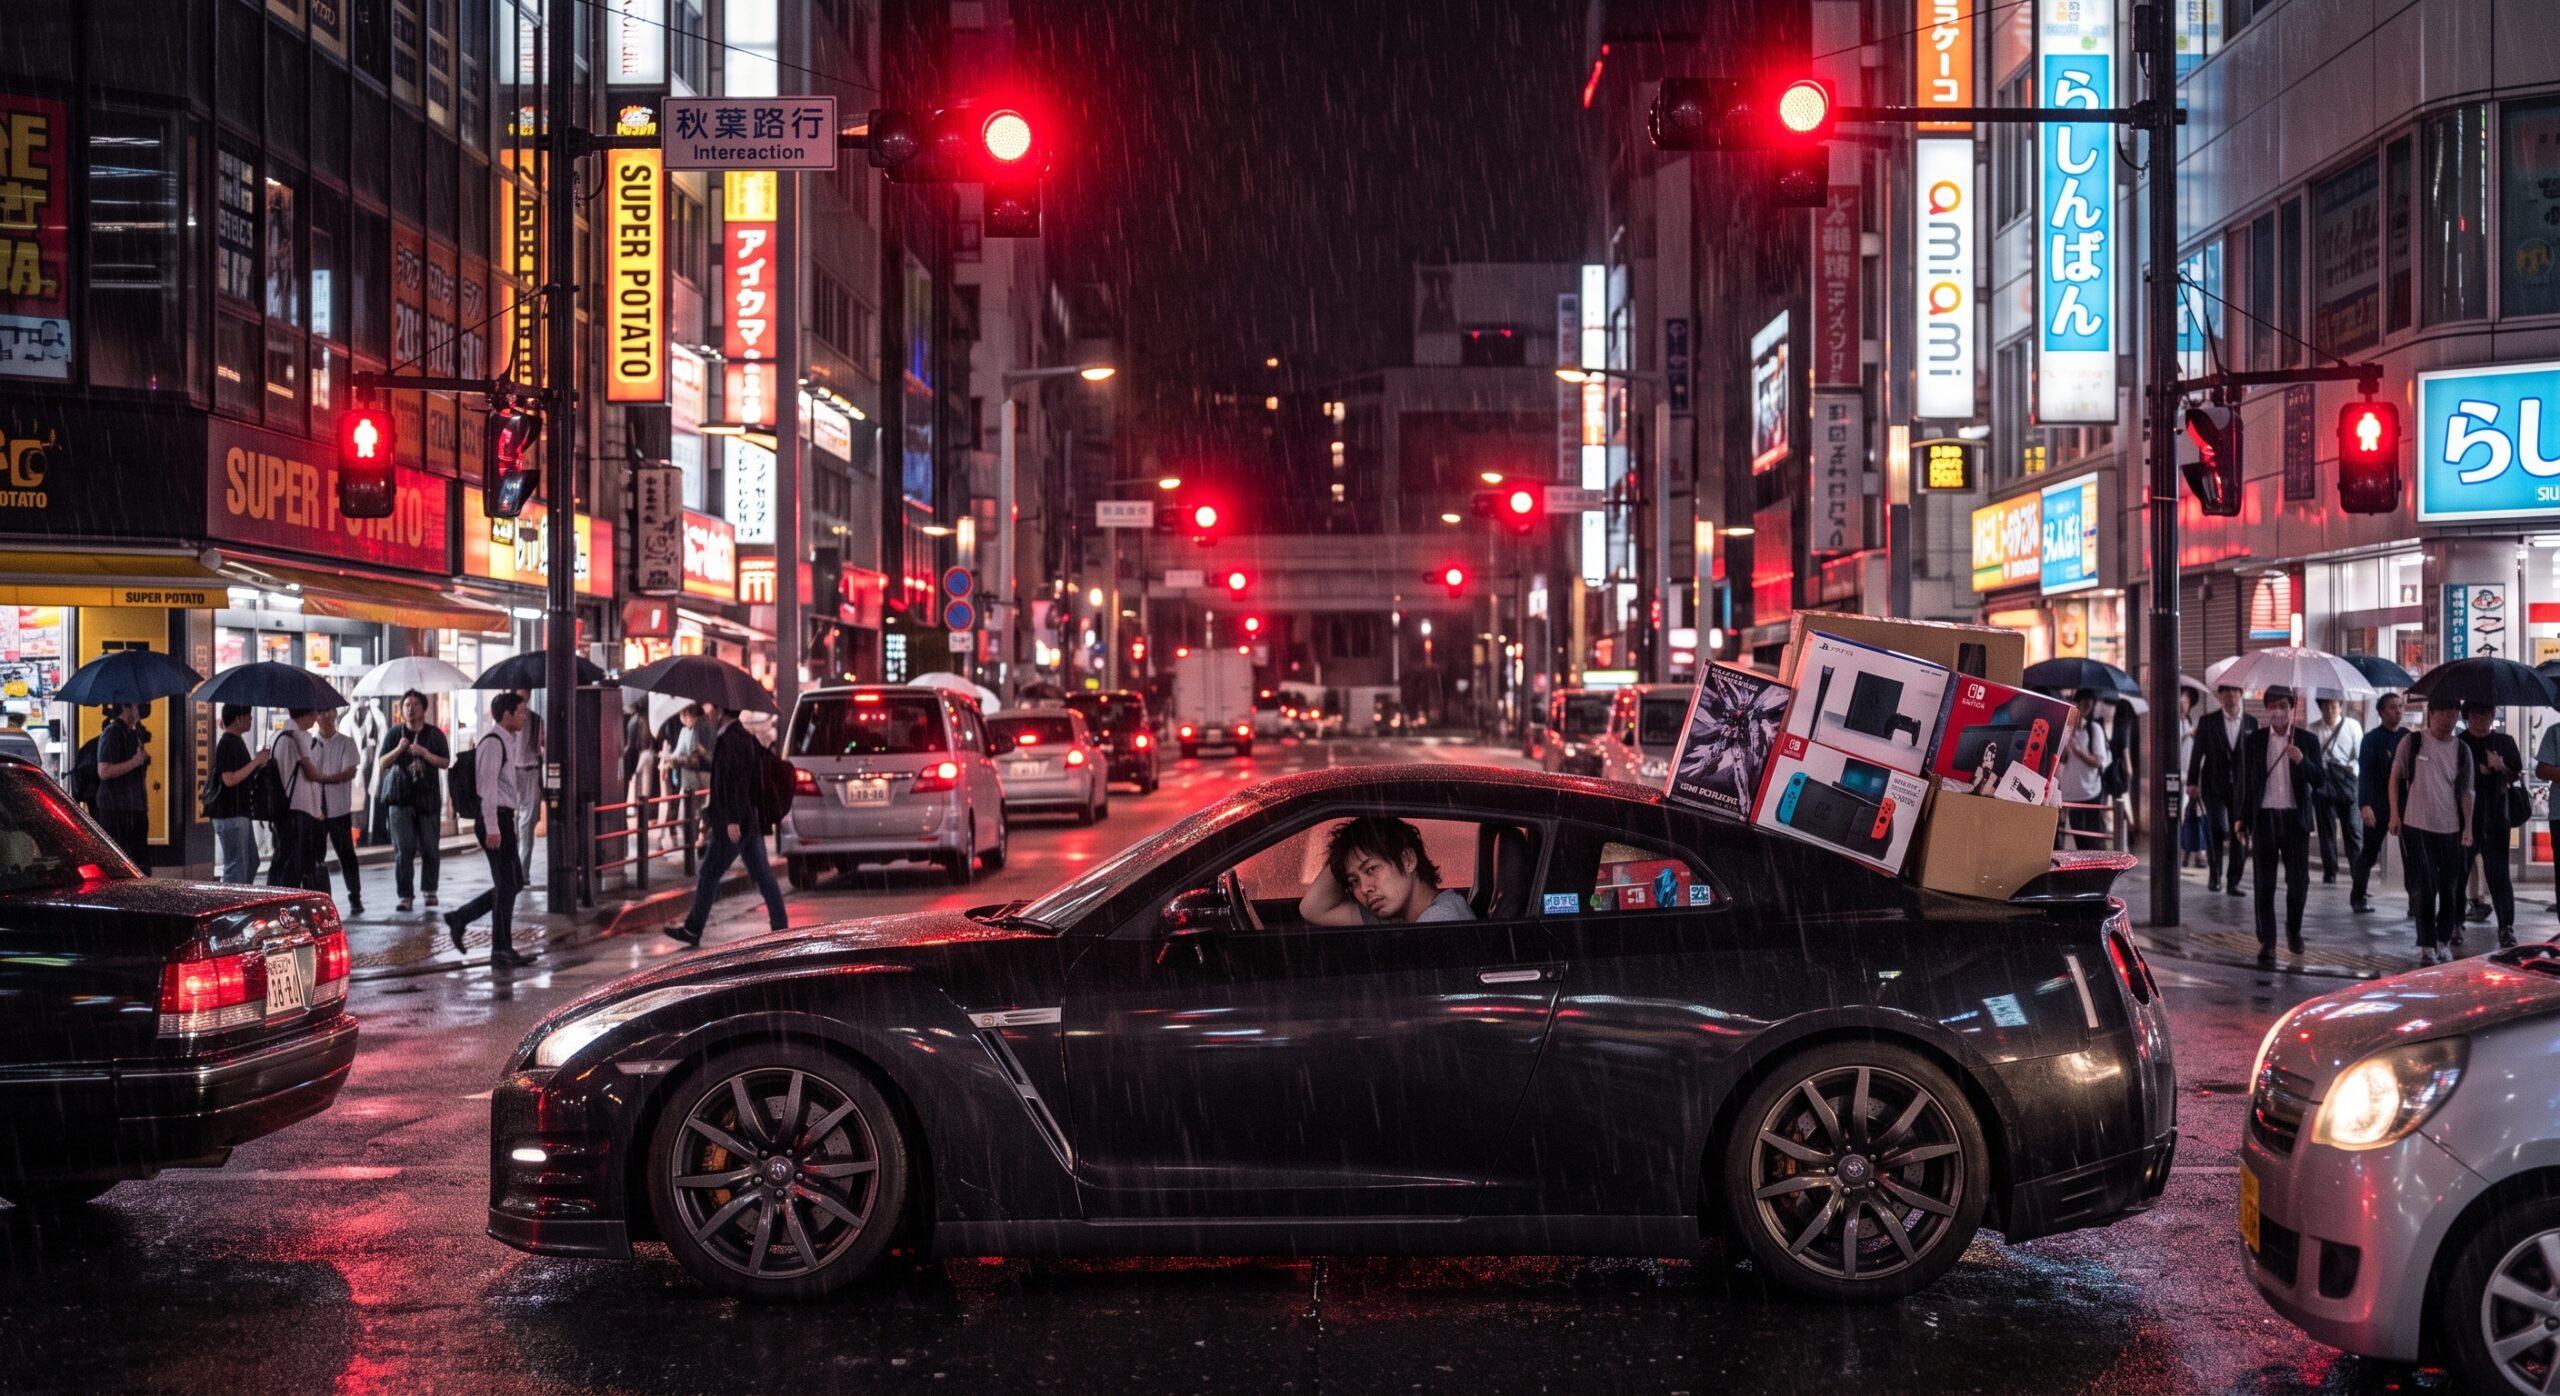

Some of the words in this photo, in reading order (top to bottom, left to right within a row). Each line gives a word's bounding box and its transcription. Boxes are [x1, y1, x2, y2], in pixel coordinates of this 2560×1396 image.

[676, 107, 824, 140] 秋葉路行
[620, 164, 652, 258] SUPER
[1928, 179, 1962, 376] amiami
[620, 270, 652, 377] POTATO
[226, 446, 320, 529] SUPER
[126, 592, 162, 604] SUPER
[164, 592, 205, 604] POTATO
